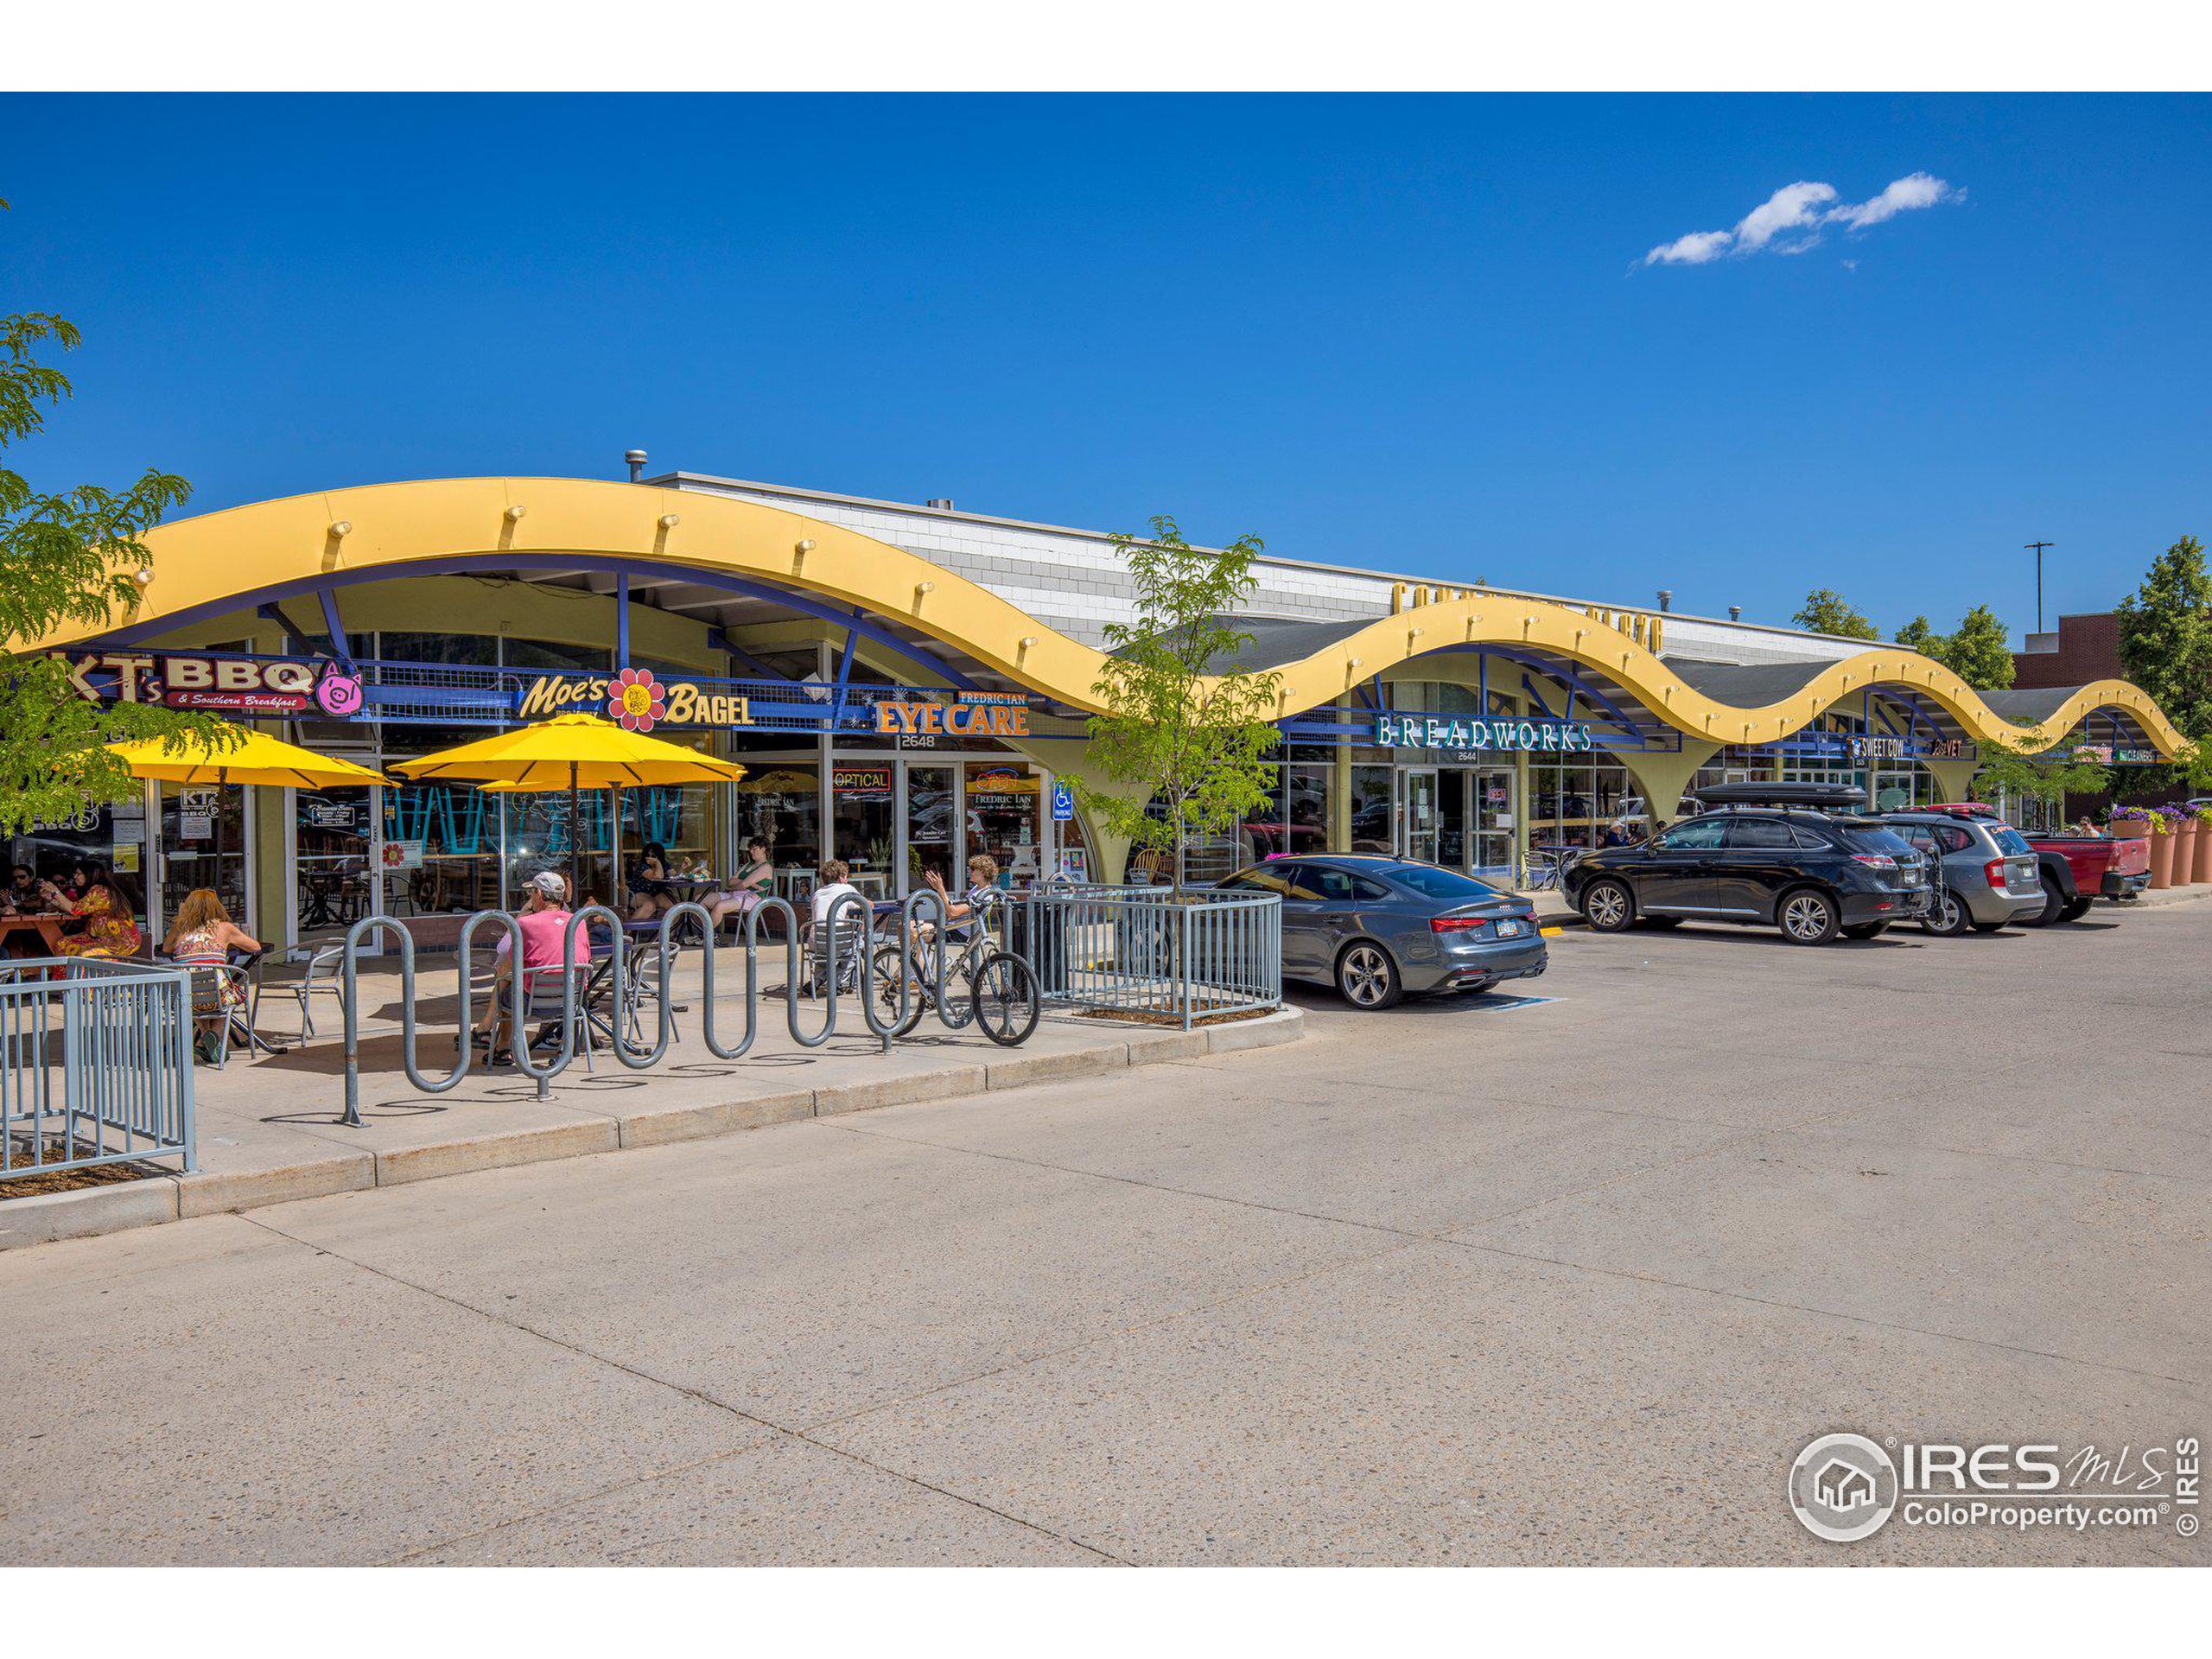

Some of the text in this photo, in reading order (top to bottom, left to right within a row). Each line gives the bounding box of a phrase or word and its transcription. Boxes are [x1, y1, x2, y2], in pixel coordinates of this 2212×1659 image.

[164, 657, 316, 695] BBQ
[178, 694, 297, 708] & Southern Breakfast
[519, 675, 609, 719] Moe's
[663, 683, 755, 725] BAGEL
[961, 691, 1027, 705] FREDRIC IAN
[902, 736, 935, 747] 2648
[1376, 716, 1592, 752] BREADWORKS
[1862, 737, 1904, 758] SWEET COW
[1458, 752, 1477, 761] 2644
[2127, 749, 2153, 762] CLEANERS
[835, 772, 887, 787] OPTICAL
[976, 772, 1019, 787] OPEN
[975, 794, 1032, 804] FREDRIC IAN
